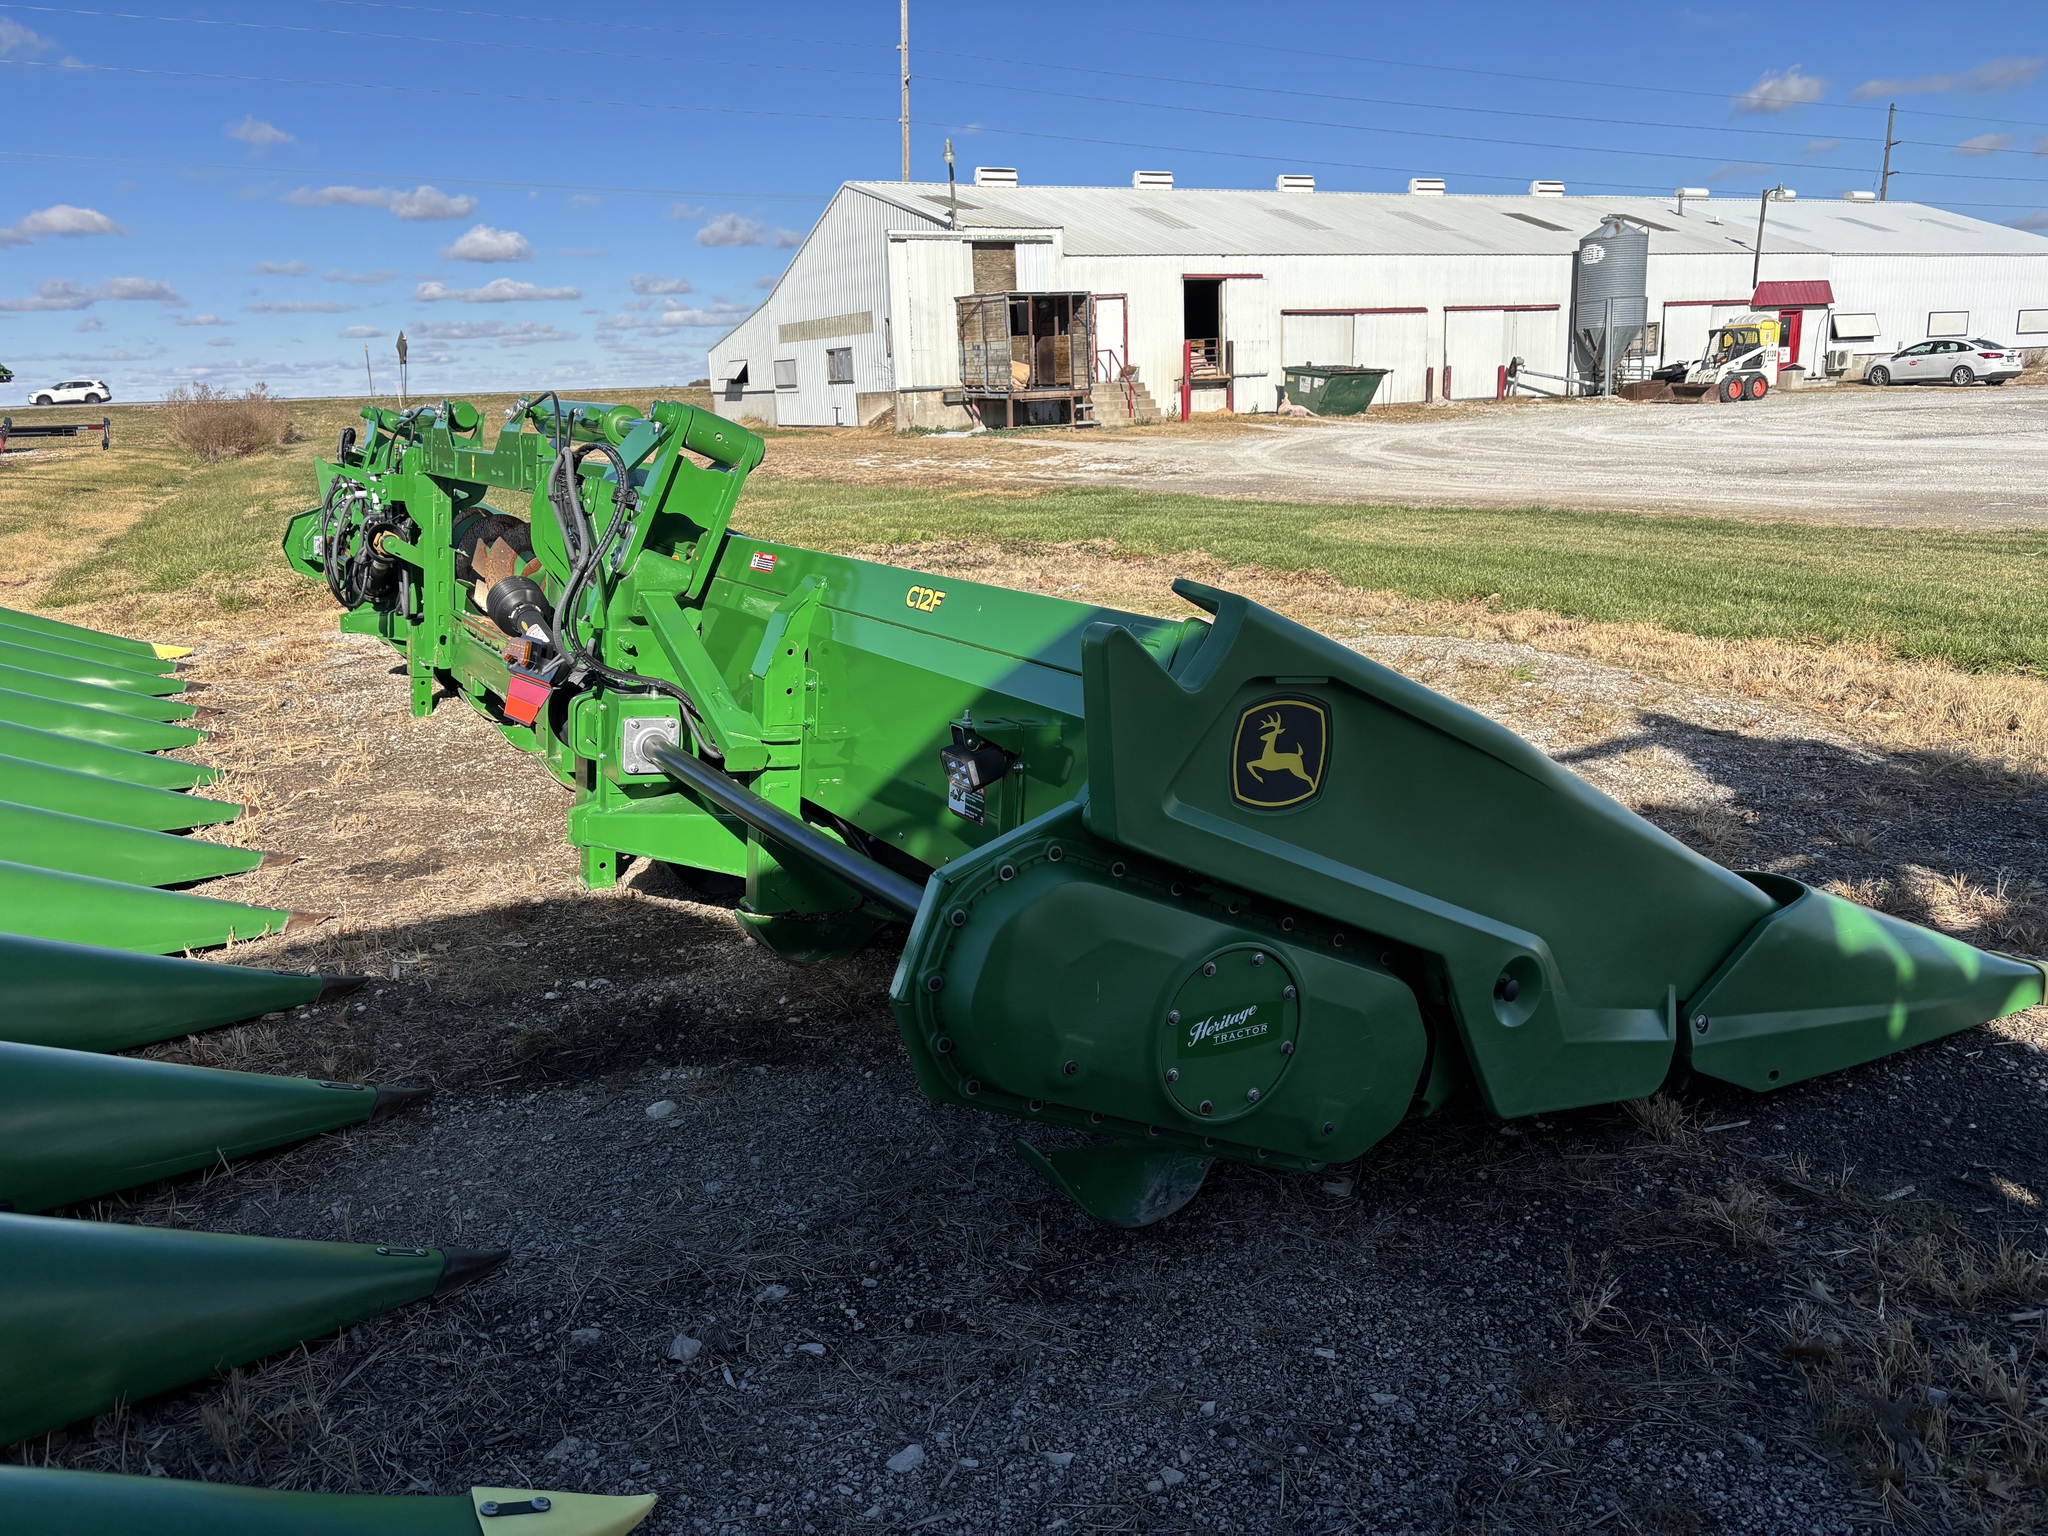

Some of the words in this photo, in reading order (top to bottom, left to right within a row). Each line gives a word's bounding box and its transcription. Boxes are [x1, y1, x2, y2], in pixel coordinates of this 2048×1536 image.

[905, 585, 946, 612] C12F
[1187, 1004, 1258, 1048] Heritage
[1213, 1024, 1268, 1044] TRACTOR
